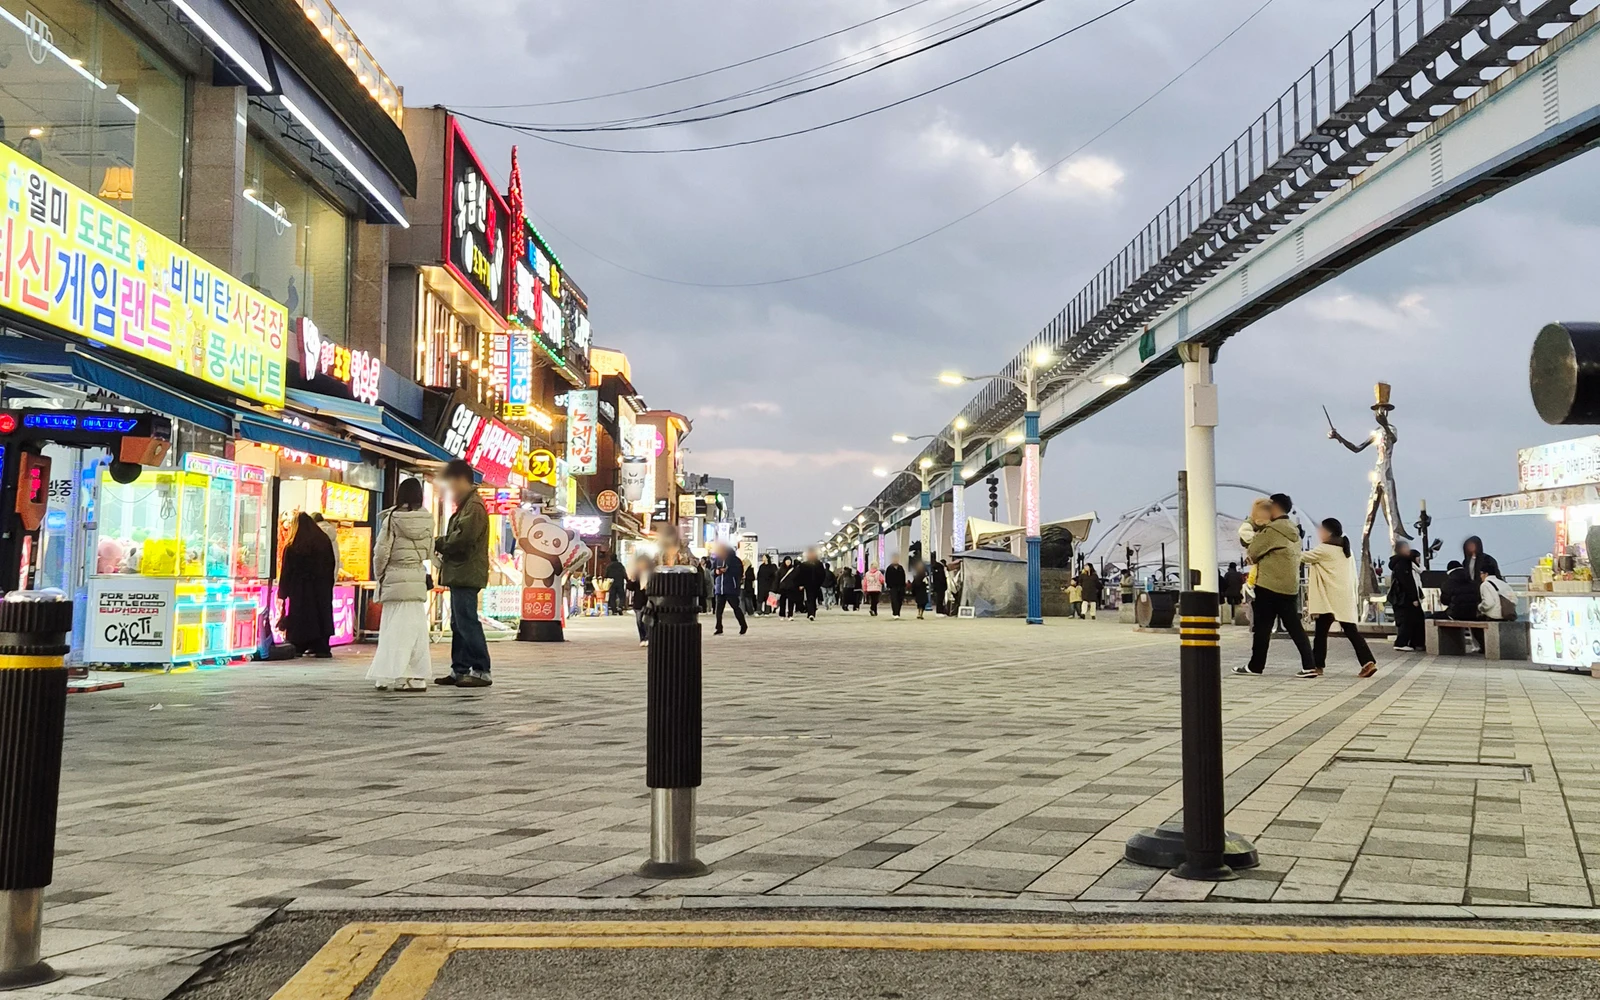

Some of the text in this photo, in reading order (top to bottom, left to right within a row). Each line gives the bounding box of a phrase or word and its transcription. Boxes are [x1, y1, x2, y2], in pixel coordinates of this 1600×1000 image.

[28, 173, 131, 263] 월미 도도도
[208, 332, 281, 396] 풍선다트
[511, 334, 527, 401] 조개구이
[571, 408, 593, 456] 노래방
[532, 463, 550, 475] 24
